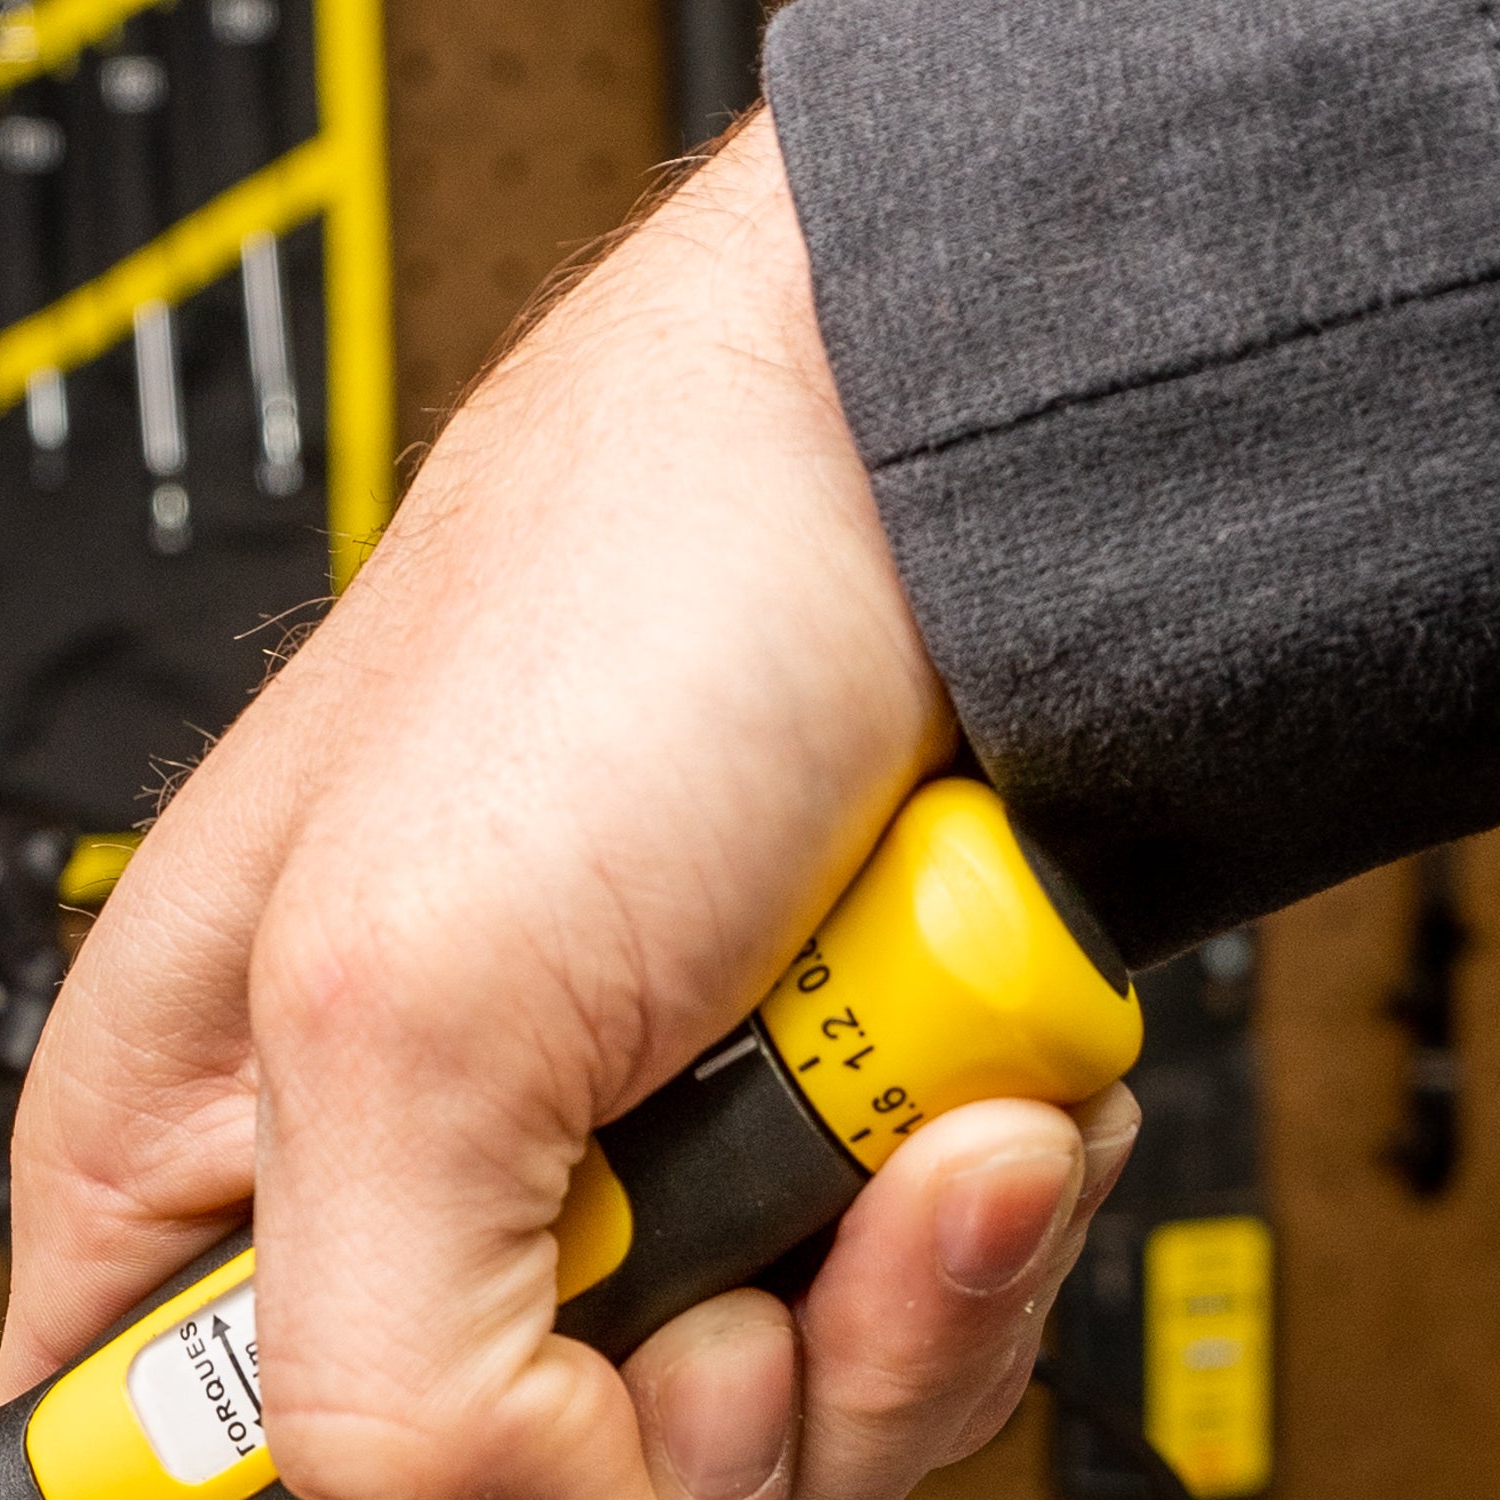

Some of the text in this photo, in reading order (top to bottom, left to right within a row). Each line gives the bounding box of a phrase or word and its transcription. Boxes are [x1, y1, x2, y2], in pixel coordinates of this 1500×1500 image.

[821, 1005, 876, 1071] 1.2
[870, 1086, 925, 1135] 1.6
[179, 1320, 257, 1457] TORQUES
